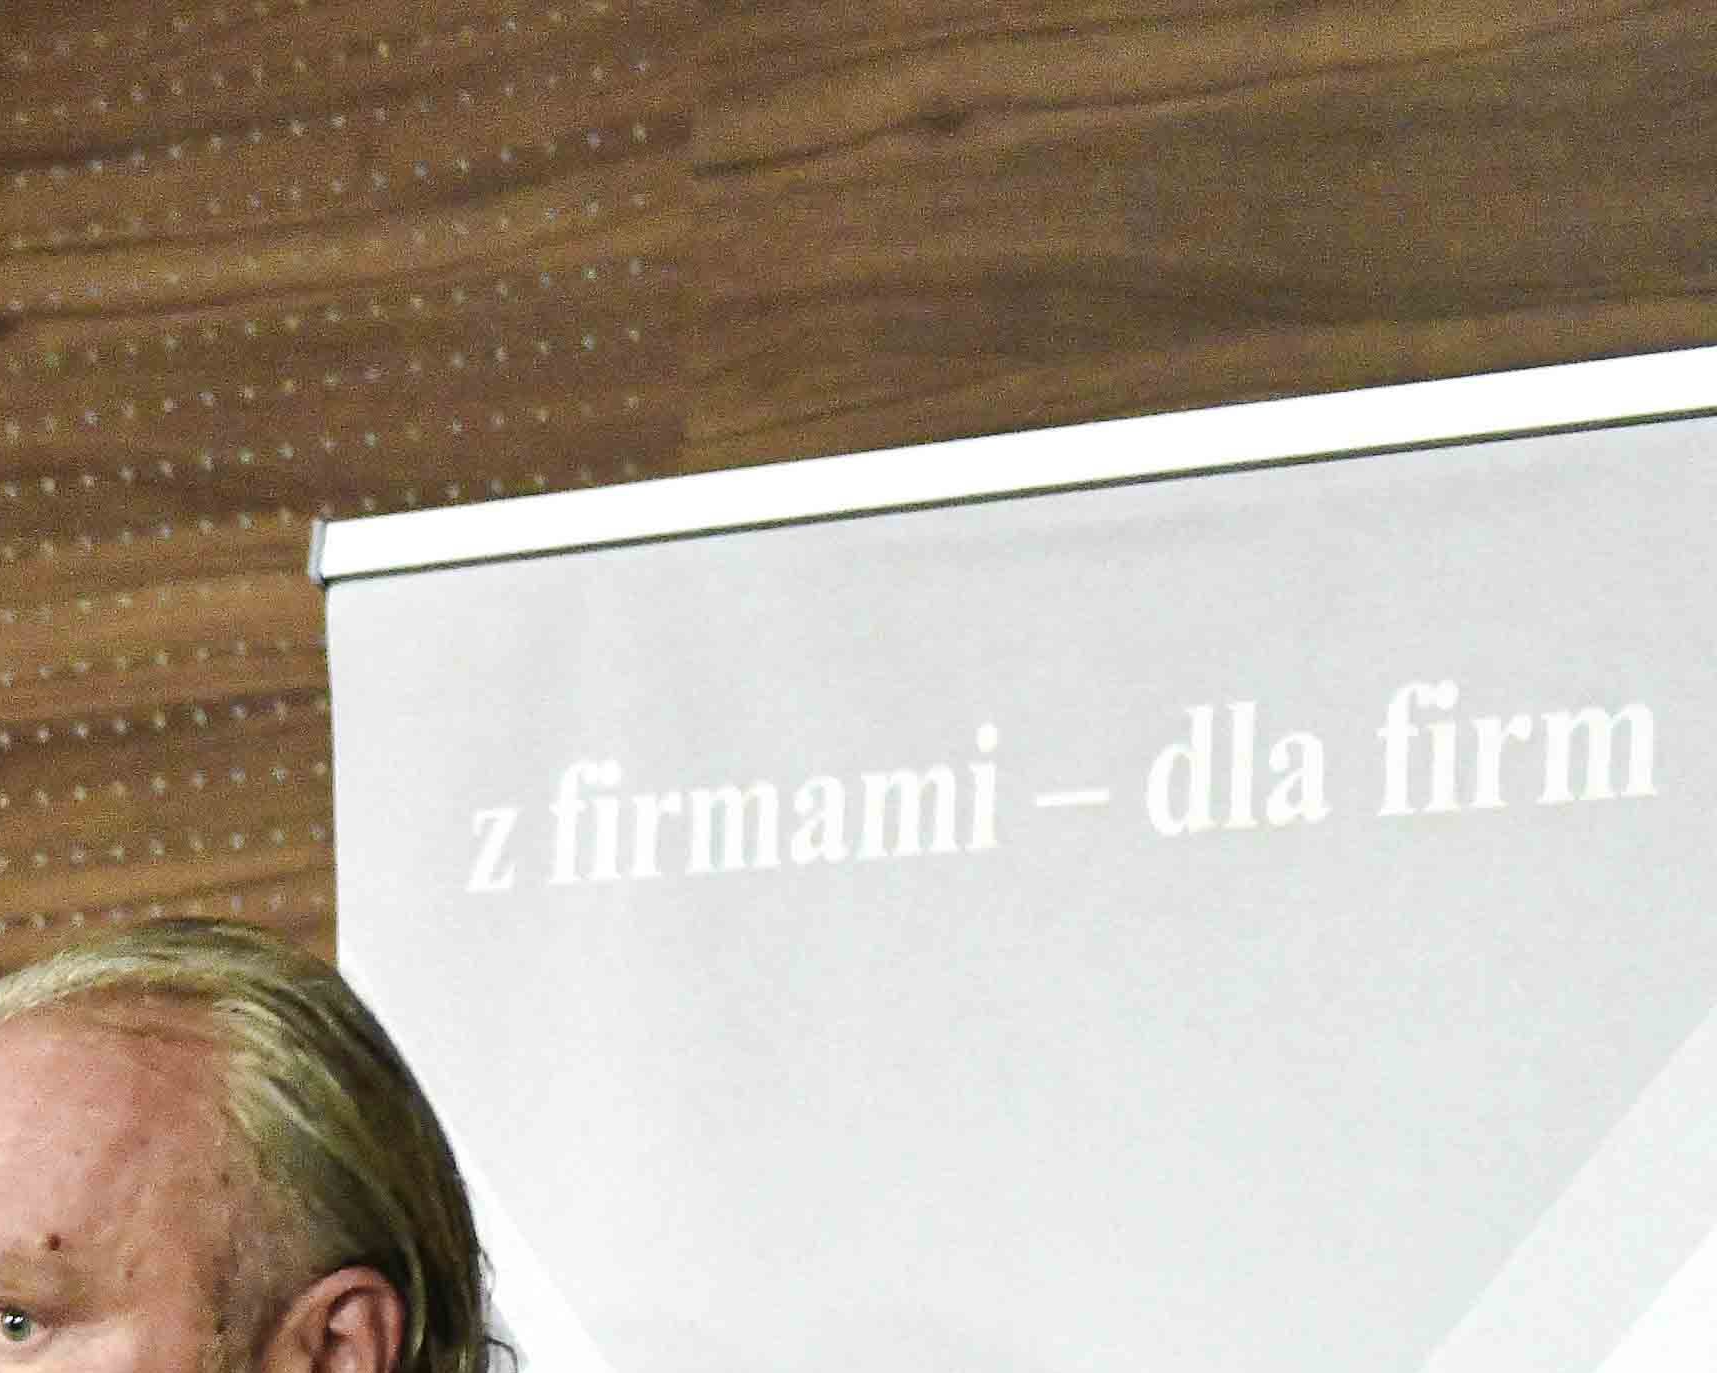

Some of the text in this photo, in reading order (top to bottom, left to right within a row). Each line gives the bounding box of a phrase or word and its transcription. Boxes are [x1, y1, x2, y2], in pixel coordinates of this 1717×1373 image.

[464, 806, 519, 894] z
[546, 722, 1001, 887] firmami
[1143, 700, 1333, 836] dla
[1373, 678, 1660, 819] firm
